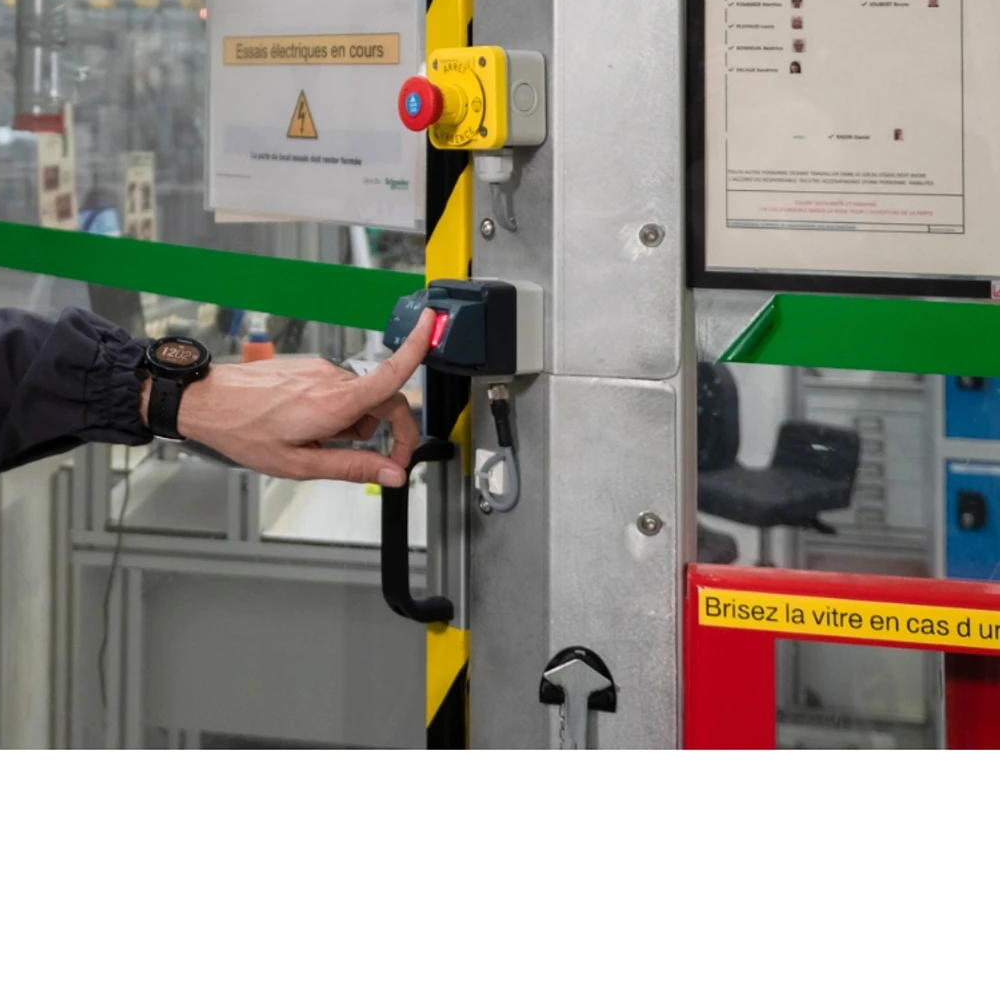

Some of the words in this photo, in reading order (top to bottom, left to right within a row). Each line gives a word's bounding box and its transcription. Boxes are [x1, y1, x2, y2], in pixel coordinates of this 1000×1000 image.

[236, 43, 268, 59] Essais
[270, 42, 328, 62] électriques
[331, 45, 346, 58] en
[349, 44, 385, 58] cours
[443, 63, 467, 74] ARRET
[705, 596, 778, 622] Brisez
[785, 603, 805, 624] la
[812, 606, 863, 629] vitre
[870, 614, 899, 632] en
[906, 617, 949, 636] cas
[957, 616, 970, 637] d
